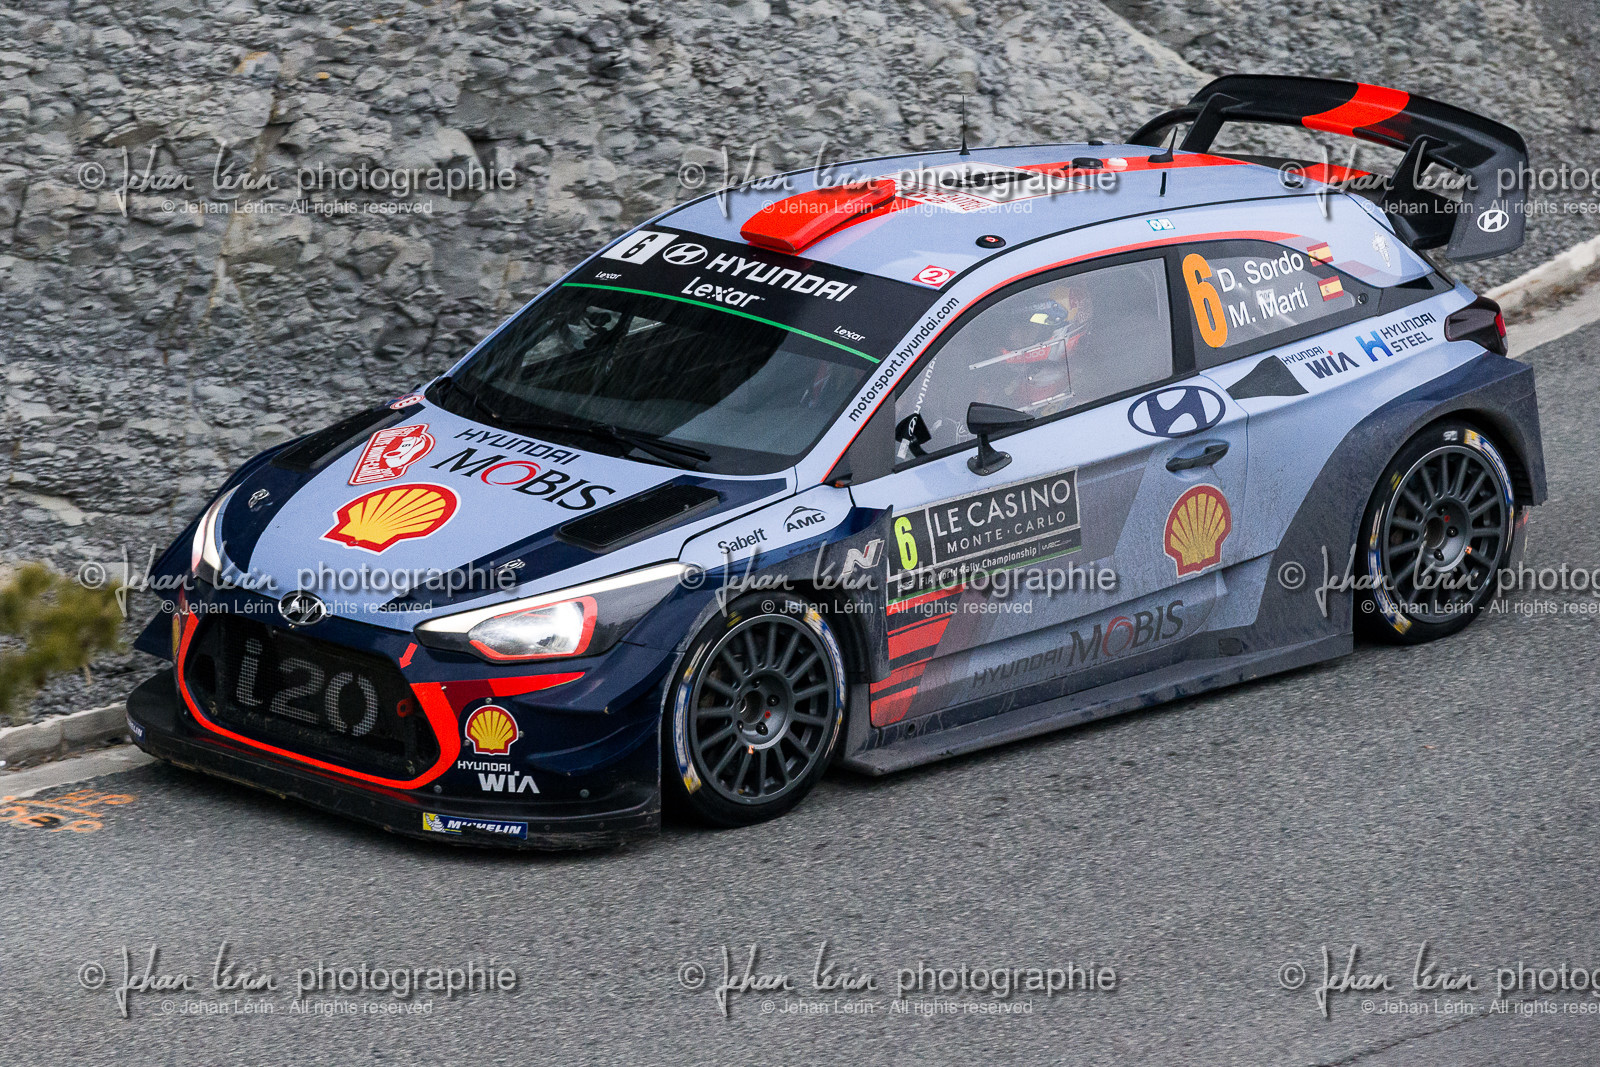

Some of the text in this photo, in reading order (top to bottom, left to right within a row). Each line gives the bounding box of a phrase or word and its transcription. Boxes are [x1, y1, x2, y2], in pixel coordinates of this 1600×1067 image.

[621, 233, 659, 259] 6
[594, 270, 622, 280] Lexar
[705, 252, 858, 302] HYUNDAI
[1216, 250, 1305, 292] D. Sordo
[681, 276, 762, 308] Lexar
[1182, 253, 1228, 348] 6
[1227, 282, 1310, 329] M. Martí
[833, 325, 866, 342] Lexar
[1380, 312, 1437, 340] HYUNDAI
[1390, 331, 1434, 353] STEEL
[848, 296, 961, 422] motorsport.hyundai.com
[1280, 345, 1325, 365] HYUNDAI
[453, 428, 581, 466] HYUNDAI
[429, 447, 617, 511] MOBIS
[786, 512, 826, 533] AMG
[933, 479, 1071, 537] LE CASINO
[717, 527, 768, 555] Sabelt
[894, 516, 918, 571] 6
[982, 547, 1038, 569] Championship
[1066, 600, 1184, 668] MOBIS
[972, 646, 1064, 689] HYUNDAI
[236, 637, 379, 737] i20
[457, 760, 511, 773] HYUNDAI
[446, 820, 522, 835] MHELIN
